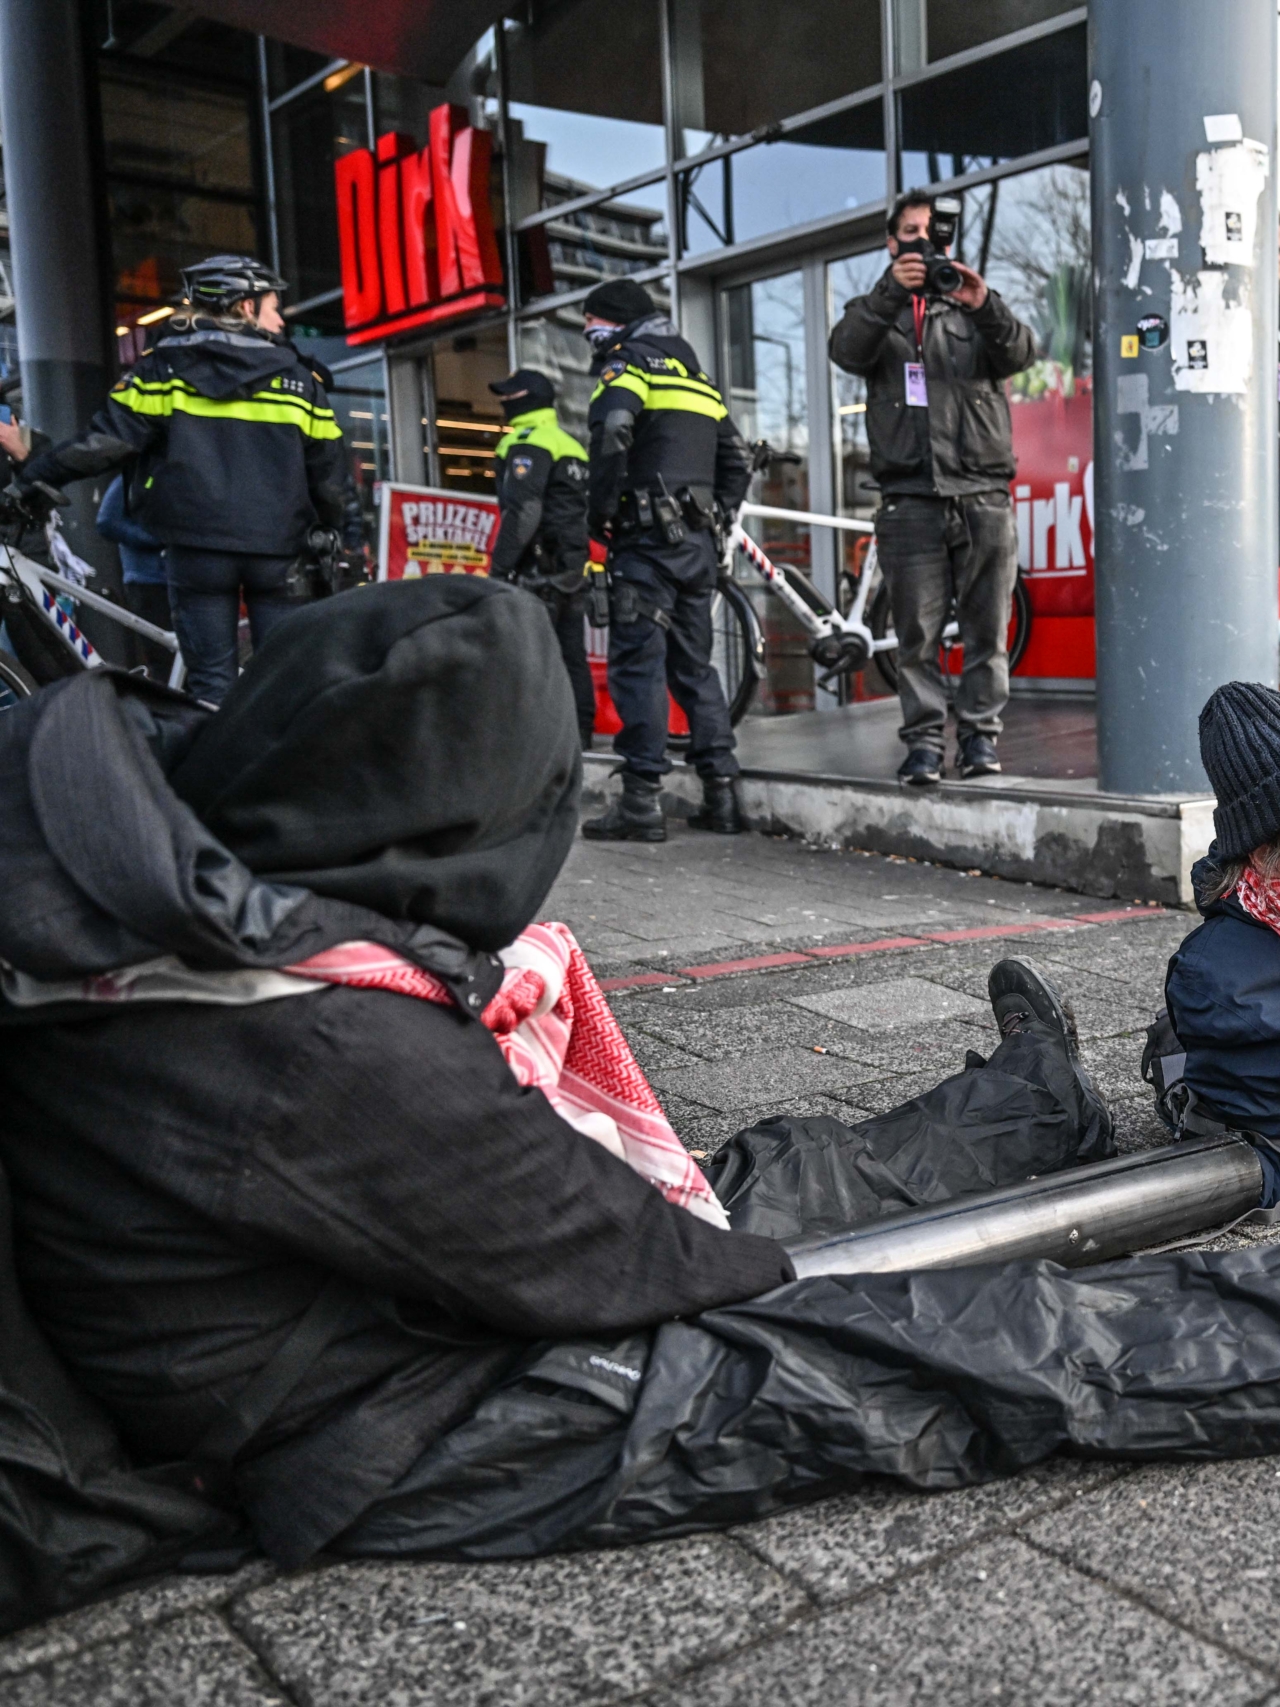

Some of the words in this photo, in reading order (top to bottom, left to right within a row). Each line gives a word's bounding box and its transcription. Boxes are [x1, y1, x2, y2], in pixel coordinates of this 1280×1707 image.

[334, 102, 503, 329] Dirk
[402, 501, 496, 534] PRIJZEN
[1014, 481, 1087, 570] irk
